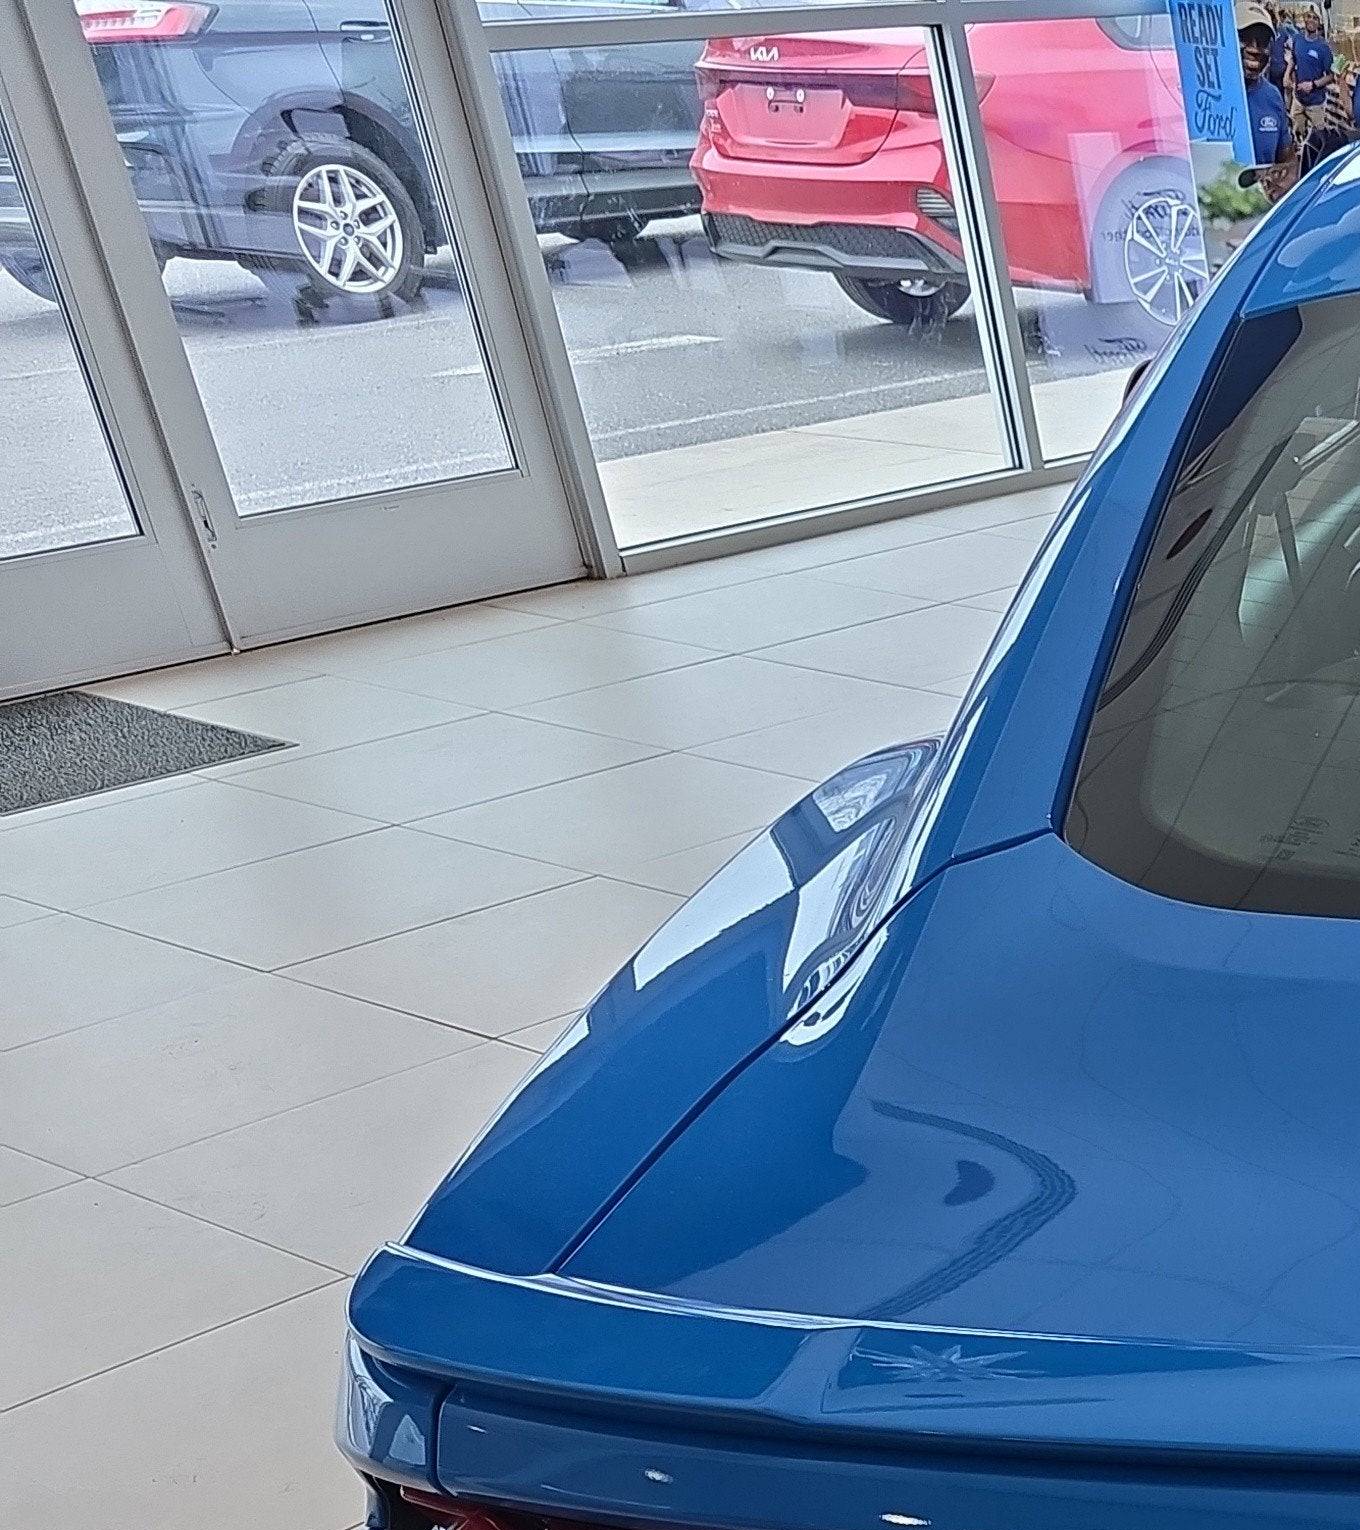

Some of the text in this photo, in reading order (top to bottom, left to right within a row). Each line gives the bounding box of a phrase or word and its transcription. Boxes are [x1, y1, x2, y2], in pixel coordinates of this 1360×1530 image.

[1178, 2, 1226, 48] READY
[1194, 46, 1222, 90] SET
[1194, 89, 1238, 137] Ford
